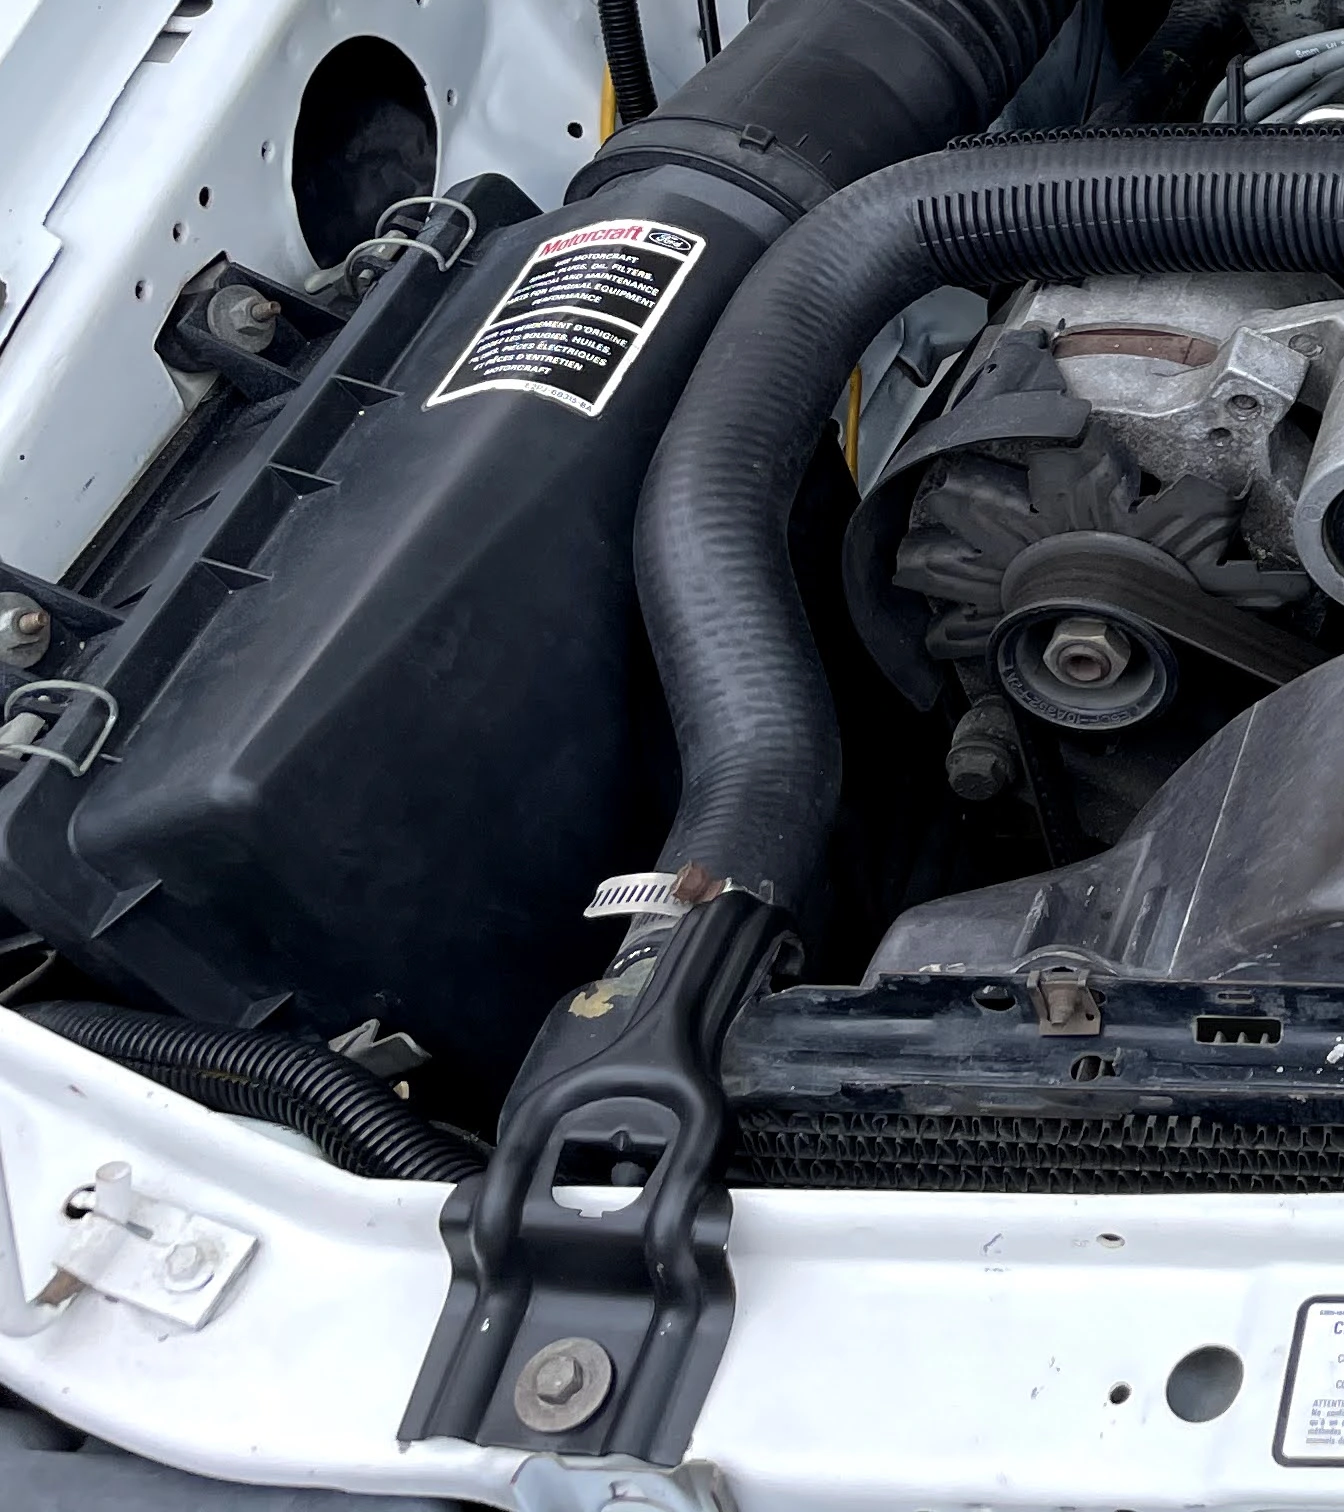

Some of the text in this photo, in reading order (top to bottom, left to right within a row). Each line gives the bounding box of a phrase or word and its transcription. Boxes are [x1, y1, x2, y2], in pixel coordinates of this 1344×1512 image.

[539, 225, 644, 257] Motorcraft
[572, 253, 640, 264] MOTORCRAFT
[612, 264, 654, 282] FILTERS,
[585, 273, 659, 296] MAINTENANCE
[532, 293, 602, 306] PERFORMANCE
[595, 284, 656, 308] EQUIPMENT
[537, 340, 608, 366] ÉLECTRIQUES
[572, 336, 612, 355] HUILES,
[484, 363, 552, 375] MOTORCRAFT
[516, 354, 584, 371] D'ENTRETIEN
